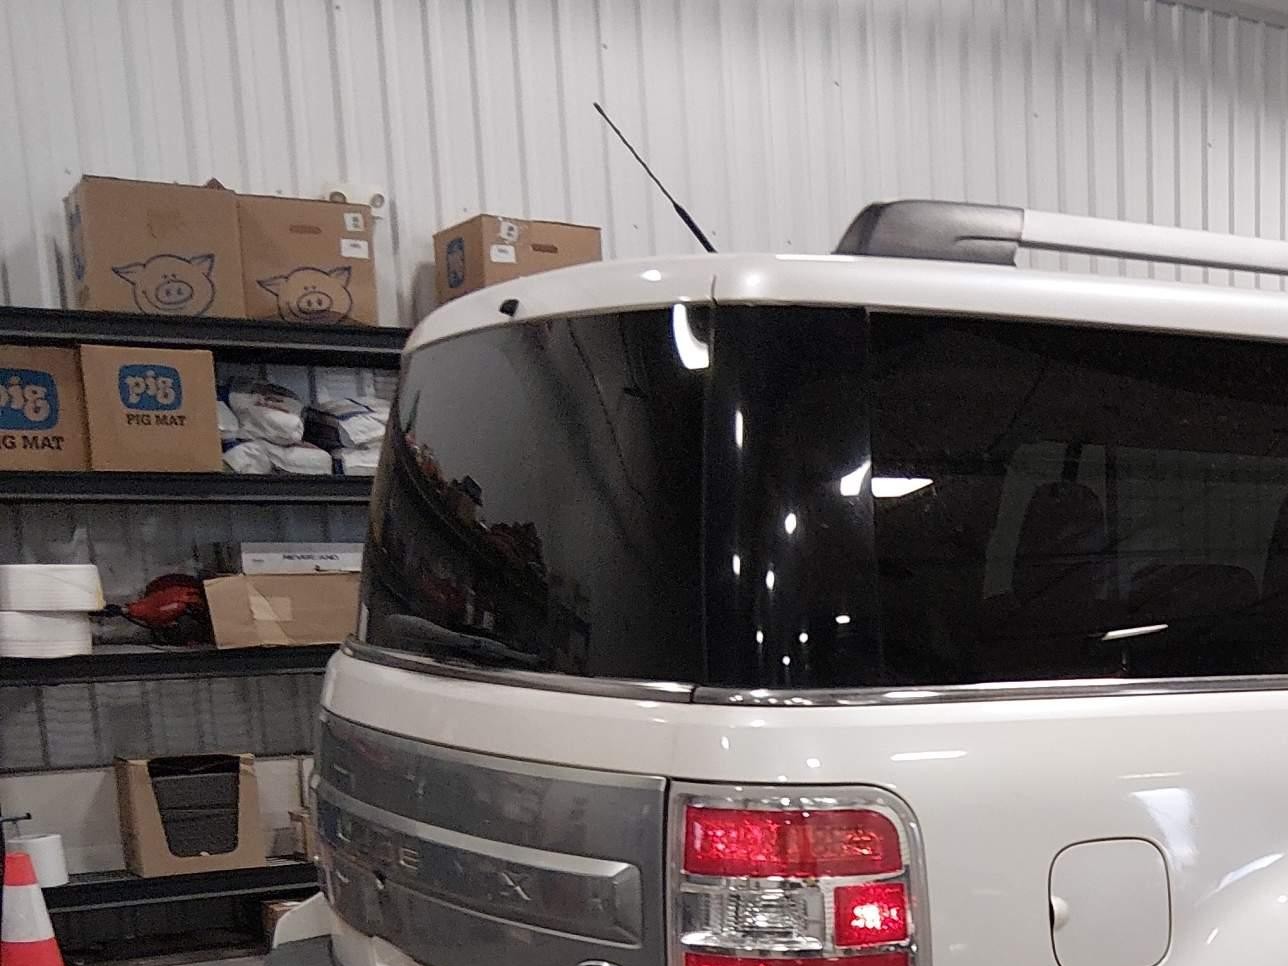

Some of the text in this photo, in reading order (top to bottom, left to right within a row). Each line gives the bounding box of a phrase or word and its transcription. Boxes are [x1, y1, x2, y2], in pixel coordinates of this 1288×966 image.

[124, 369, 176, 405] pig
[126, 413, 187, 426] PIG MAT
[22, 435, 65, 451] MAT
